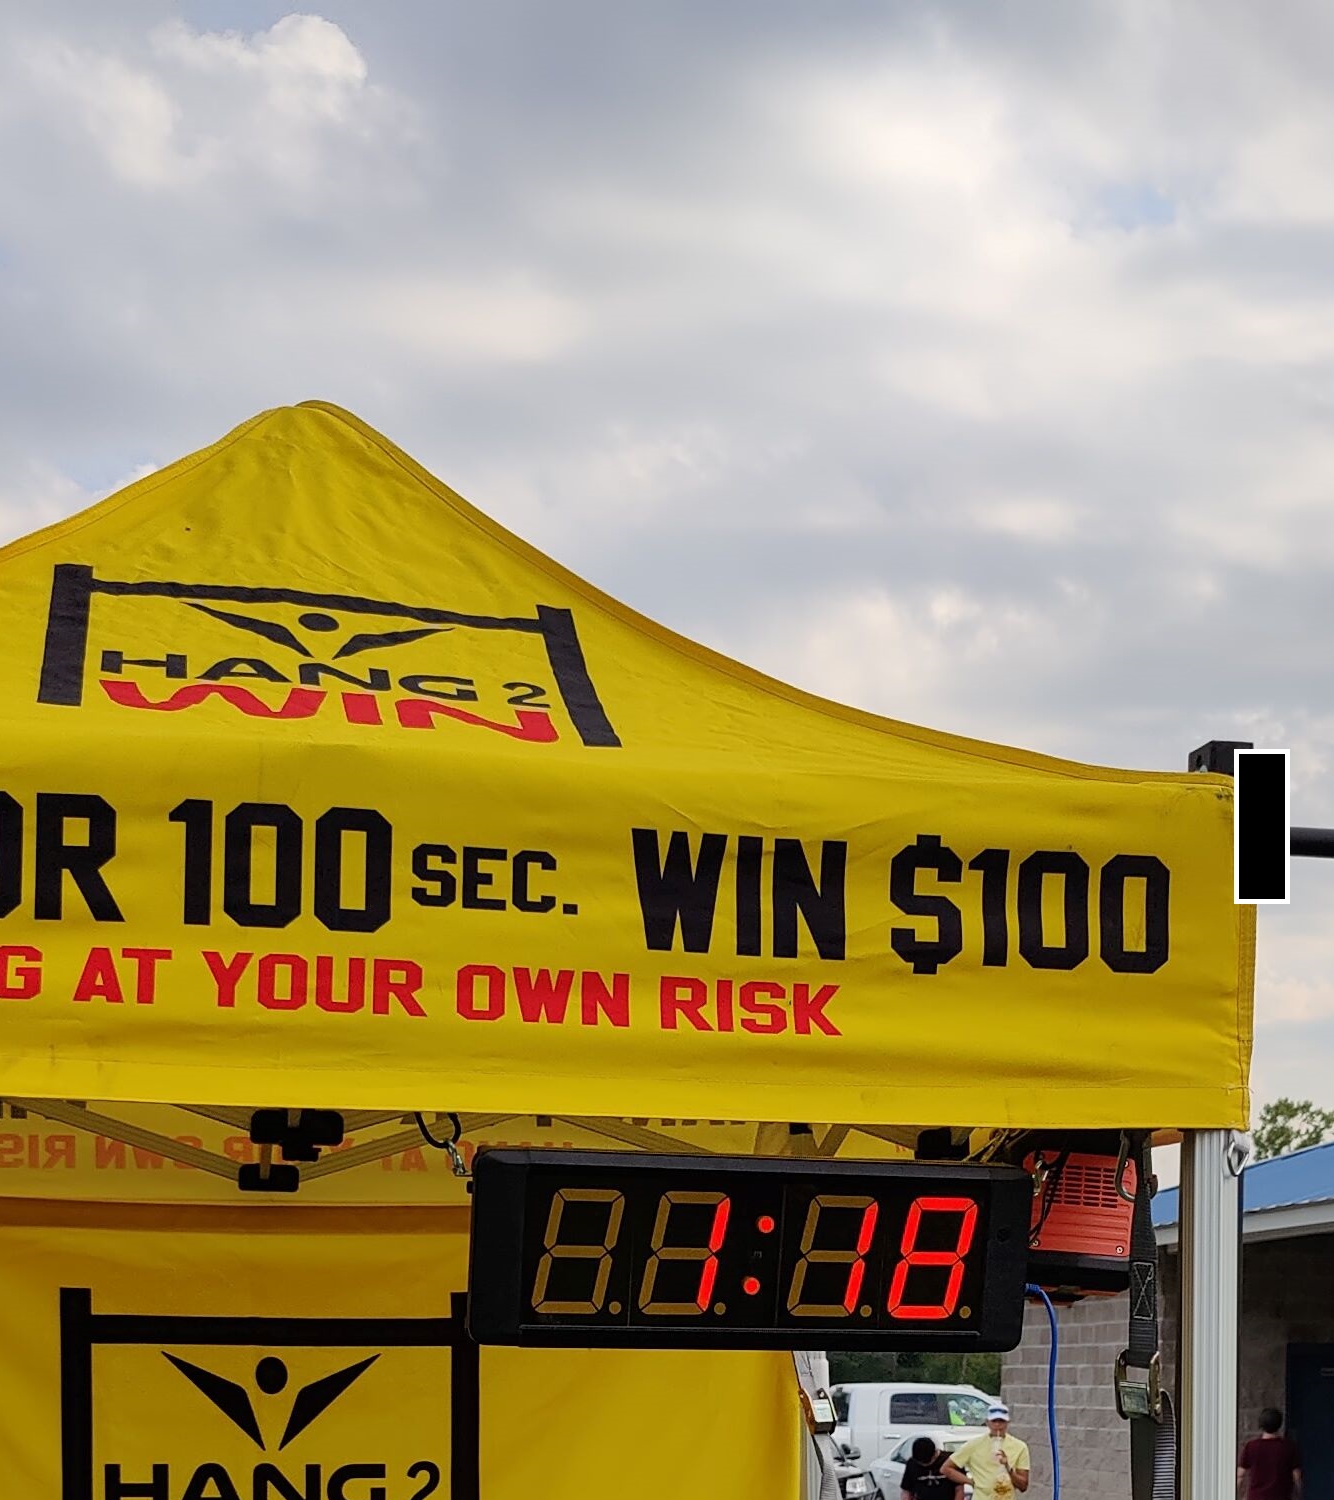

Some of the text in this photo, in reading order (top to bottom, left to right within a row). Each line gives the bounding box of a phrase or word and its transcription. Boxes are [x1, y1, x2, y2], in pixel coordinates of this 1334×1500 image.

[99, 679, 558, 743] WIN
[100, 650, 550, 708] HANG 2
[168, 798, 393, 933] 100
[411, 843, 578, 915] SEC.
[631, 827, 848, 961] WIN
[889, 834, 1171, 975] $100
[73, 947, 172, 1005] AT
[201, 951, 428, 1017] YOUR
[456, 964, 630, 1028] OWN
[659, 975, 842, 1036] RISK
